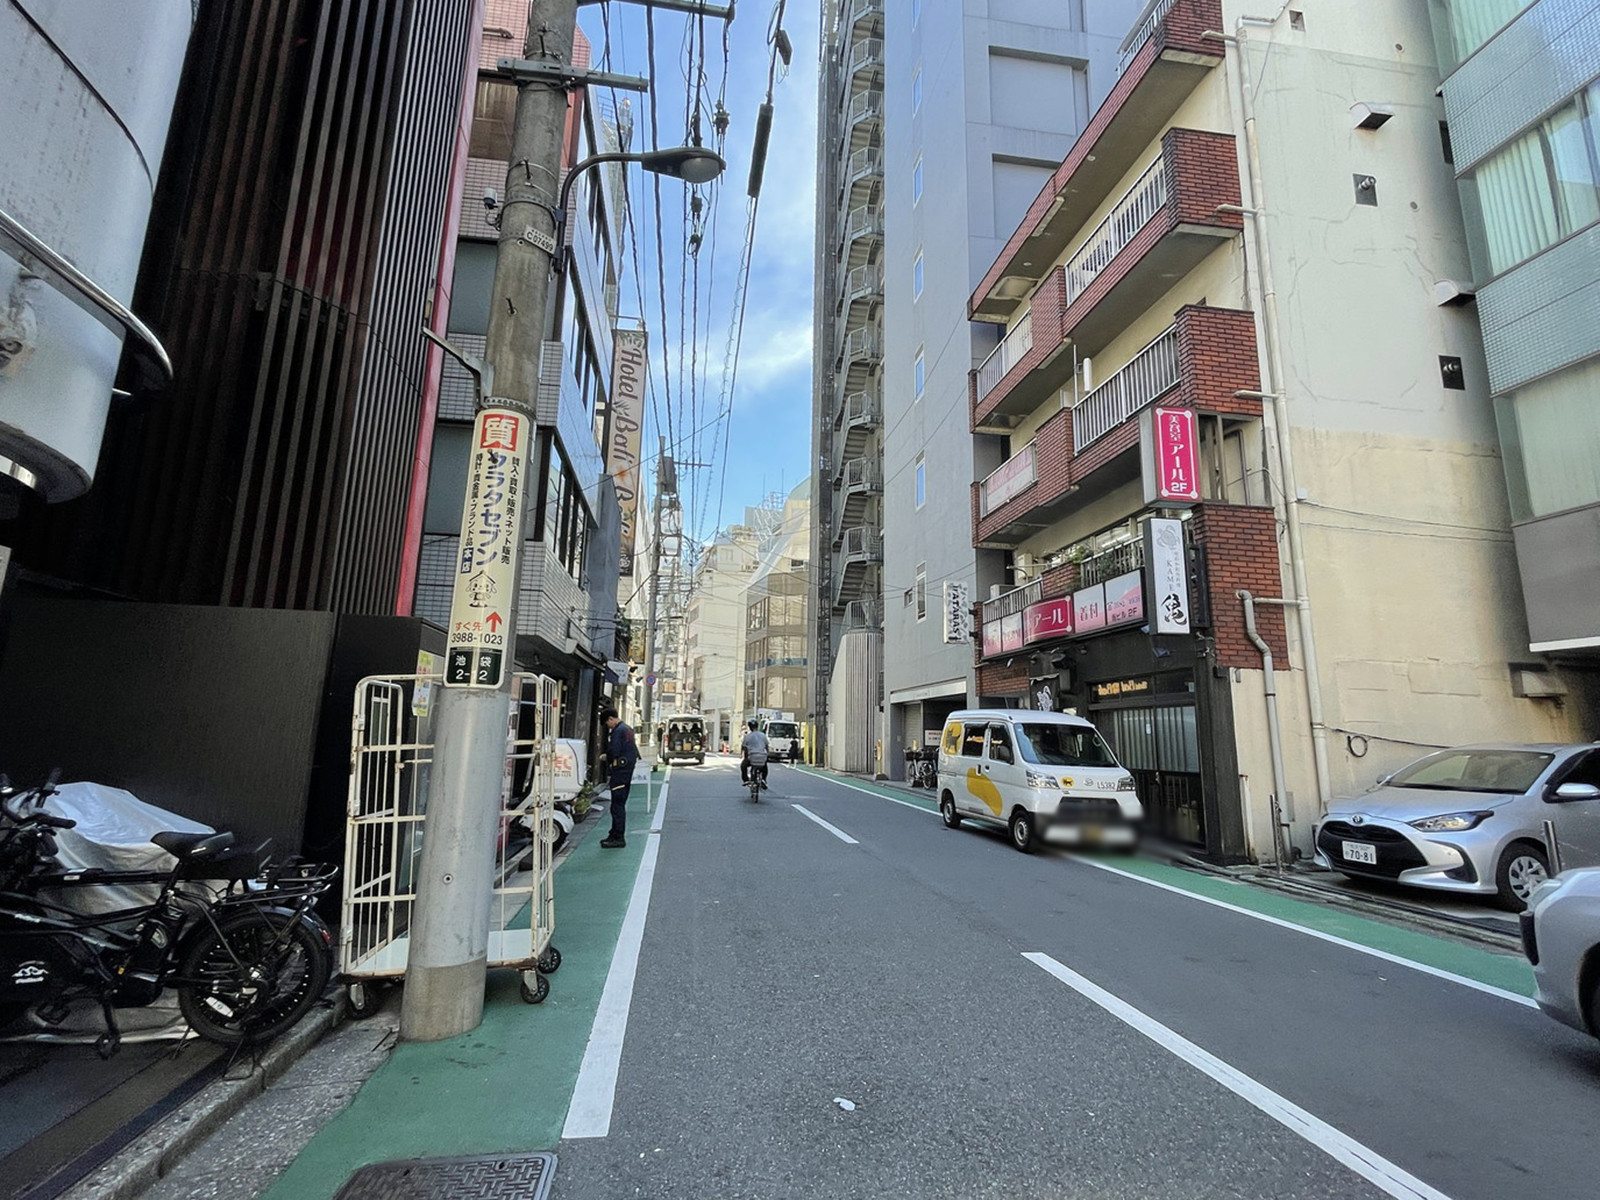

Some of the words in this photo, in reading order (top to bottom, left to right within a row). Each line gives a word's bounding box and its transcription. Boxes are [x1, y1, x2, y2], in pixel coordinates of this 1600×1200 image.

[618, 348, 643, 400] Hotel
[482, 417, 516, 448] 質
[613, 415, 639, 464] Bali
[1169, 442, 1187, 481] アール
[1171, 482, 1188, 493] 2F
[475, 451, 507, 566] クラタセブン
[1034, 607, 1065, 629] アール
[451, 632, 504, 645] 3988-1023
[455, 654, 492, 667] 池袋
[1350, 849, 1373, 863] 70-81
